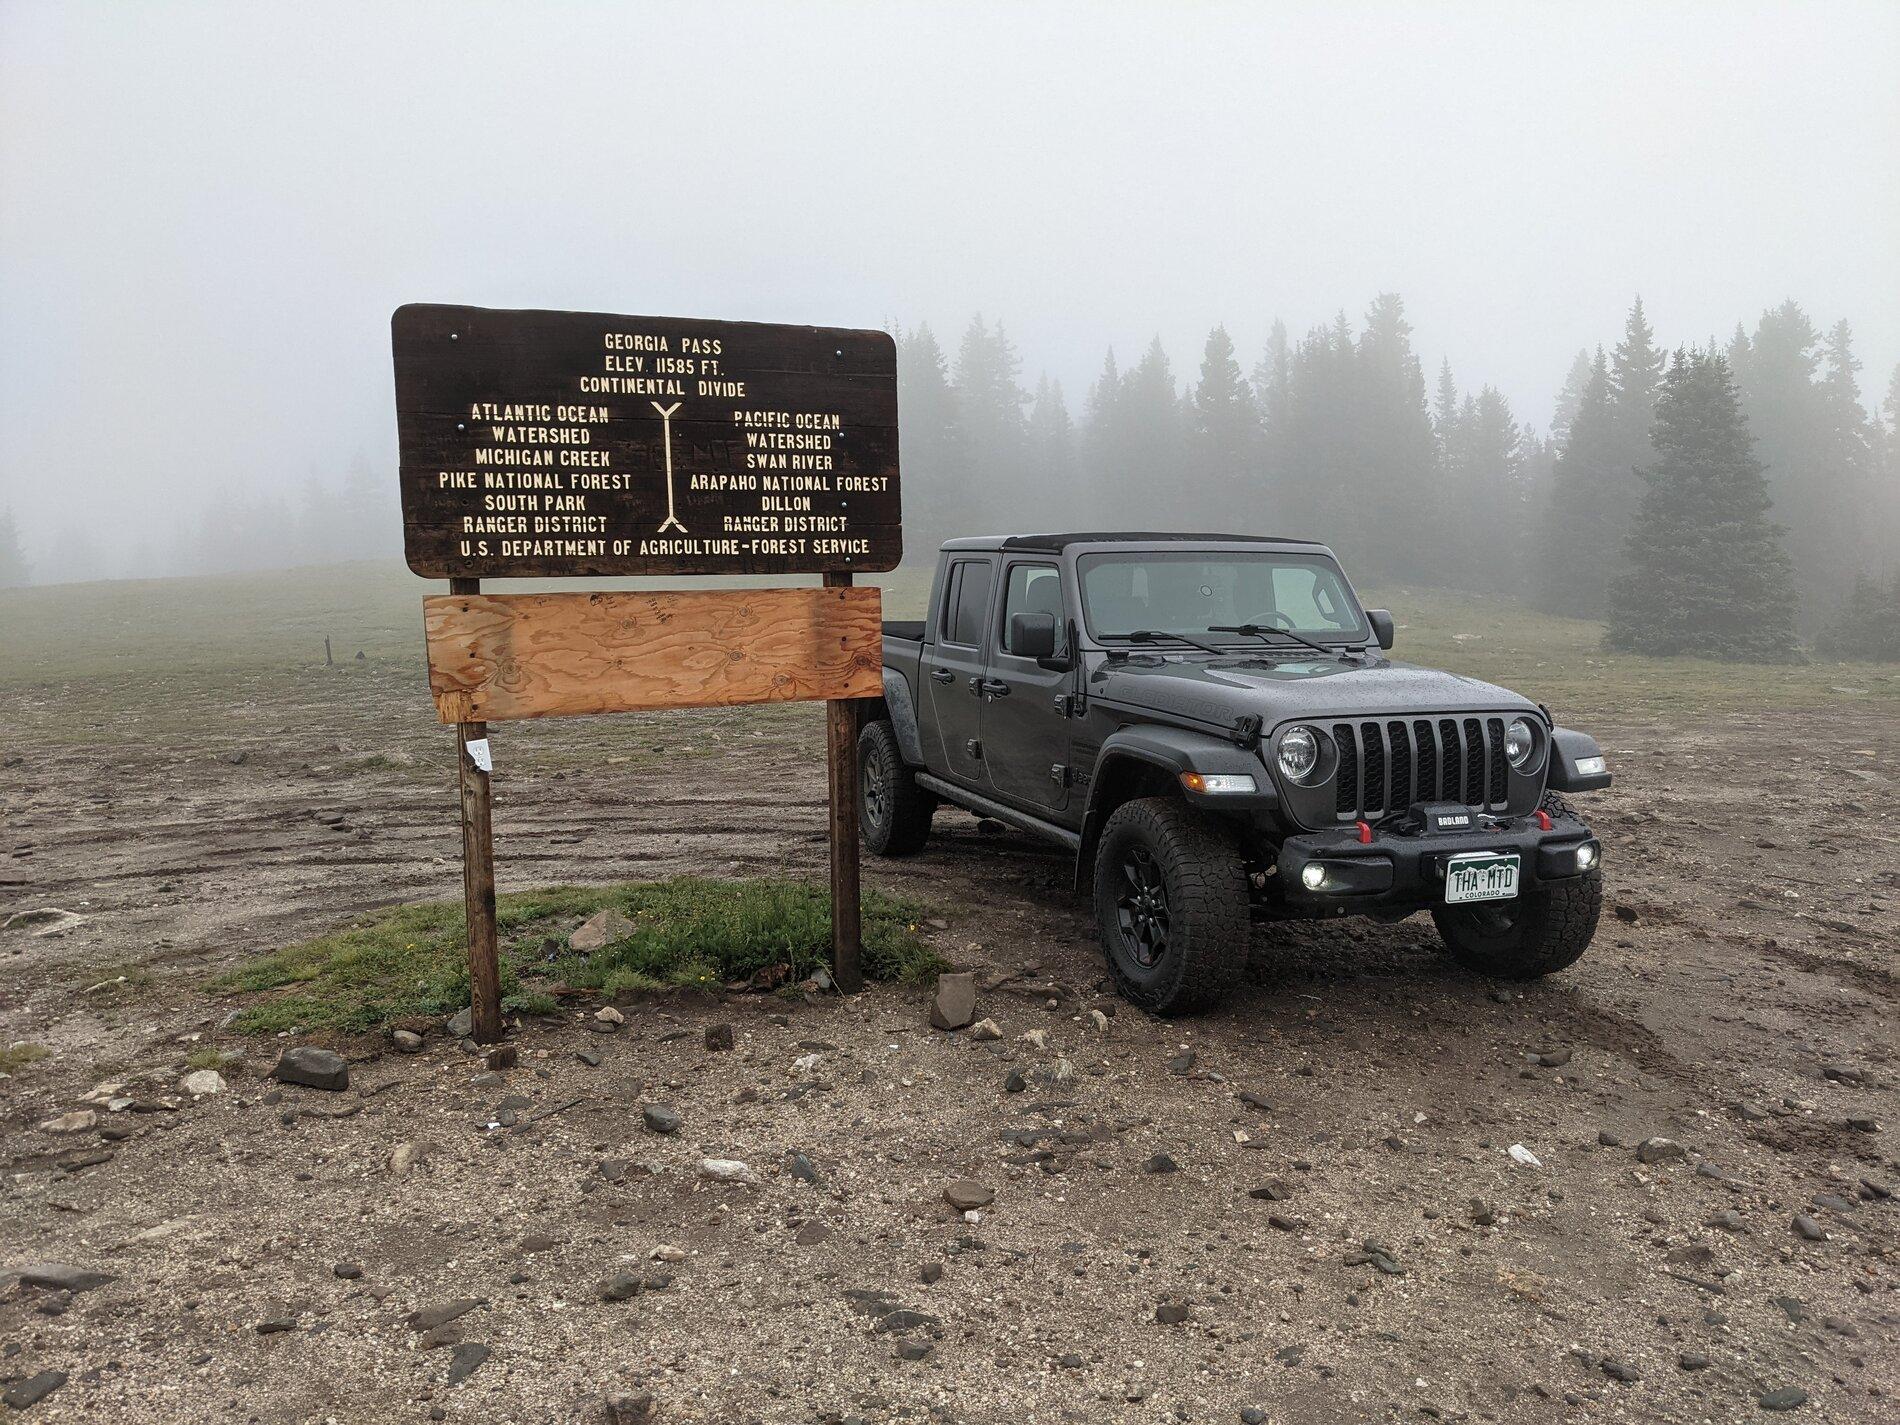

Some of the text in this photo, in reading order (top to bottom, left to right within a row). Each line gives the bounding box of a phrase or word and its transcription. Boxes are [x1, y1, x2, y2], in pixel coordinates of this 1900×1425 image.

[604, 333, 722, 355] GEORGIA PASS
[604, 355, 725, 376] ELEV. 11585 FT.
[580, 376, 746, 398] CONTINENTAL DIVIDE
[471, 403, 609, 424] ATLANTIC OCEAN
[734, 410, 840, 430] PACIFIC OCEAN
[491, 426, 590, 445] WATERSHED
[746, 432, 831, 450] WATERSHED
[475, 448, 610, 467] MICHIGAN CREEK
[746, 453, 833, 470] SWAN RIVER
[439, 471, 631, 490] PIKE NATIONAL FOREST
[690, 474, 888, 492] ARAPAHO NATIONAL FOREST
[484, 494, 586, 511] SOUTH PARK
[761, 495, 811, 511] DILLON
[463, 515, 607, 534] RANGER DISTRICT
[723, 515, 847, 533] RANGER DISTRICT
[460, 540, 494, 557] U.S.
[501, 538, 606, 557] DEPARTMENT
[613, 539, 632, 556] OF
[813, 538, 870, 554] SERVICE
[1464, 889, 1500, 899] COLORADO
